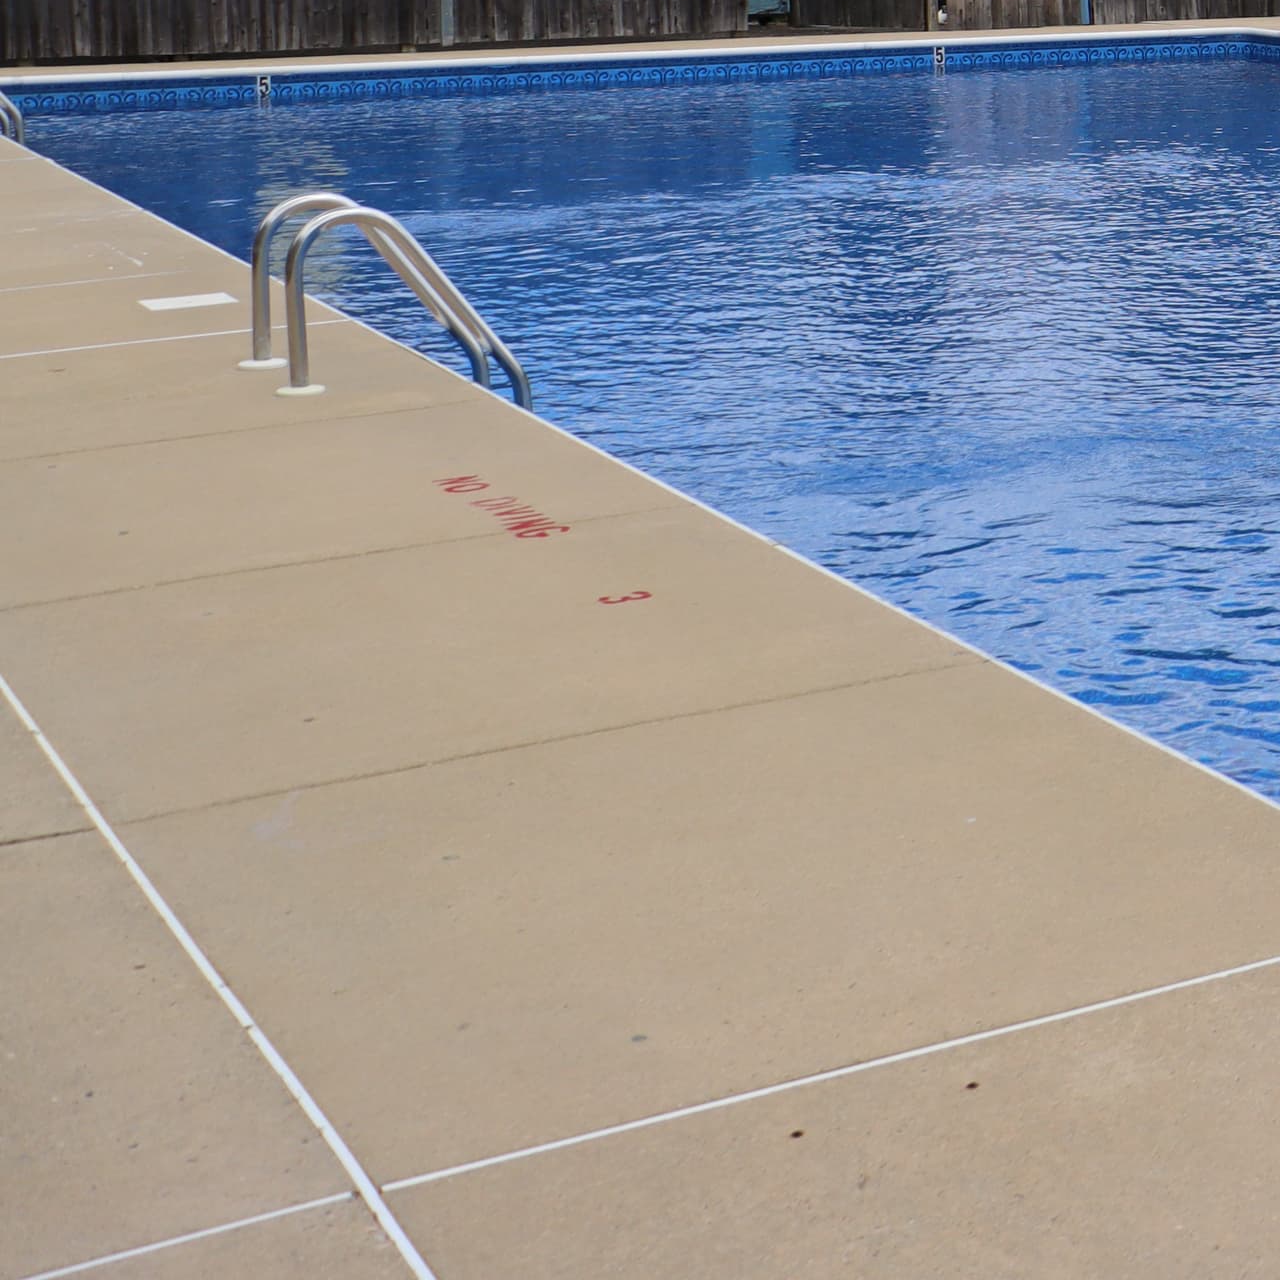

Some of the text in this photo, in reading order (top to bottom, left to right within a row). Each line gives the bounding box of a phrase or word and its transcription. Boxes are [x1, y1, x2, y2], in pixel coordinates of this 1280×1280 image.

[936, 47, 944, 63] 5
[259, 76, 269, 95] 5
[432, 474, 570, 539] NO DIVING
[597, 591, 653, 605] 3
